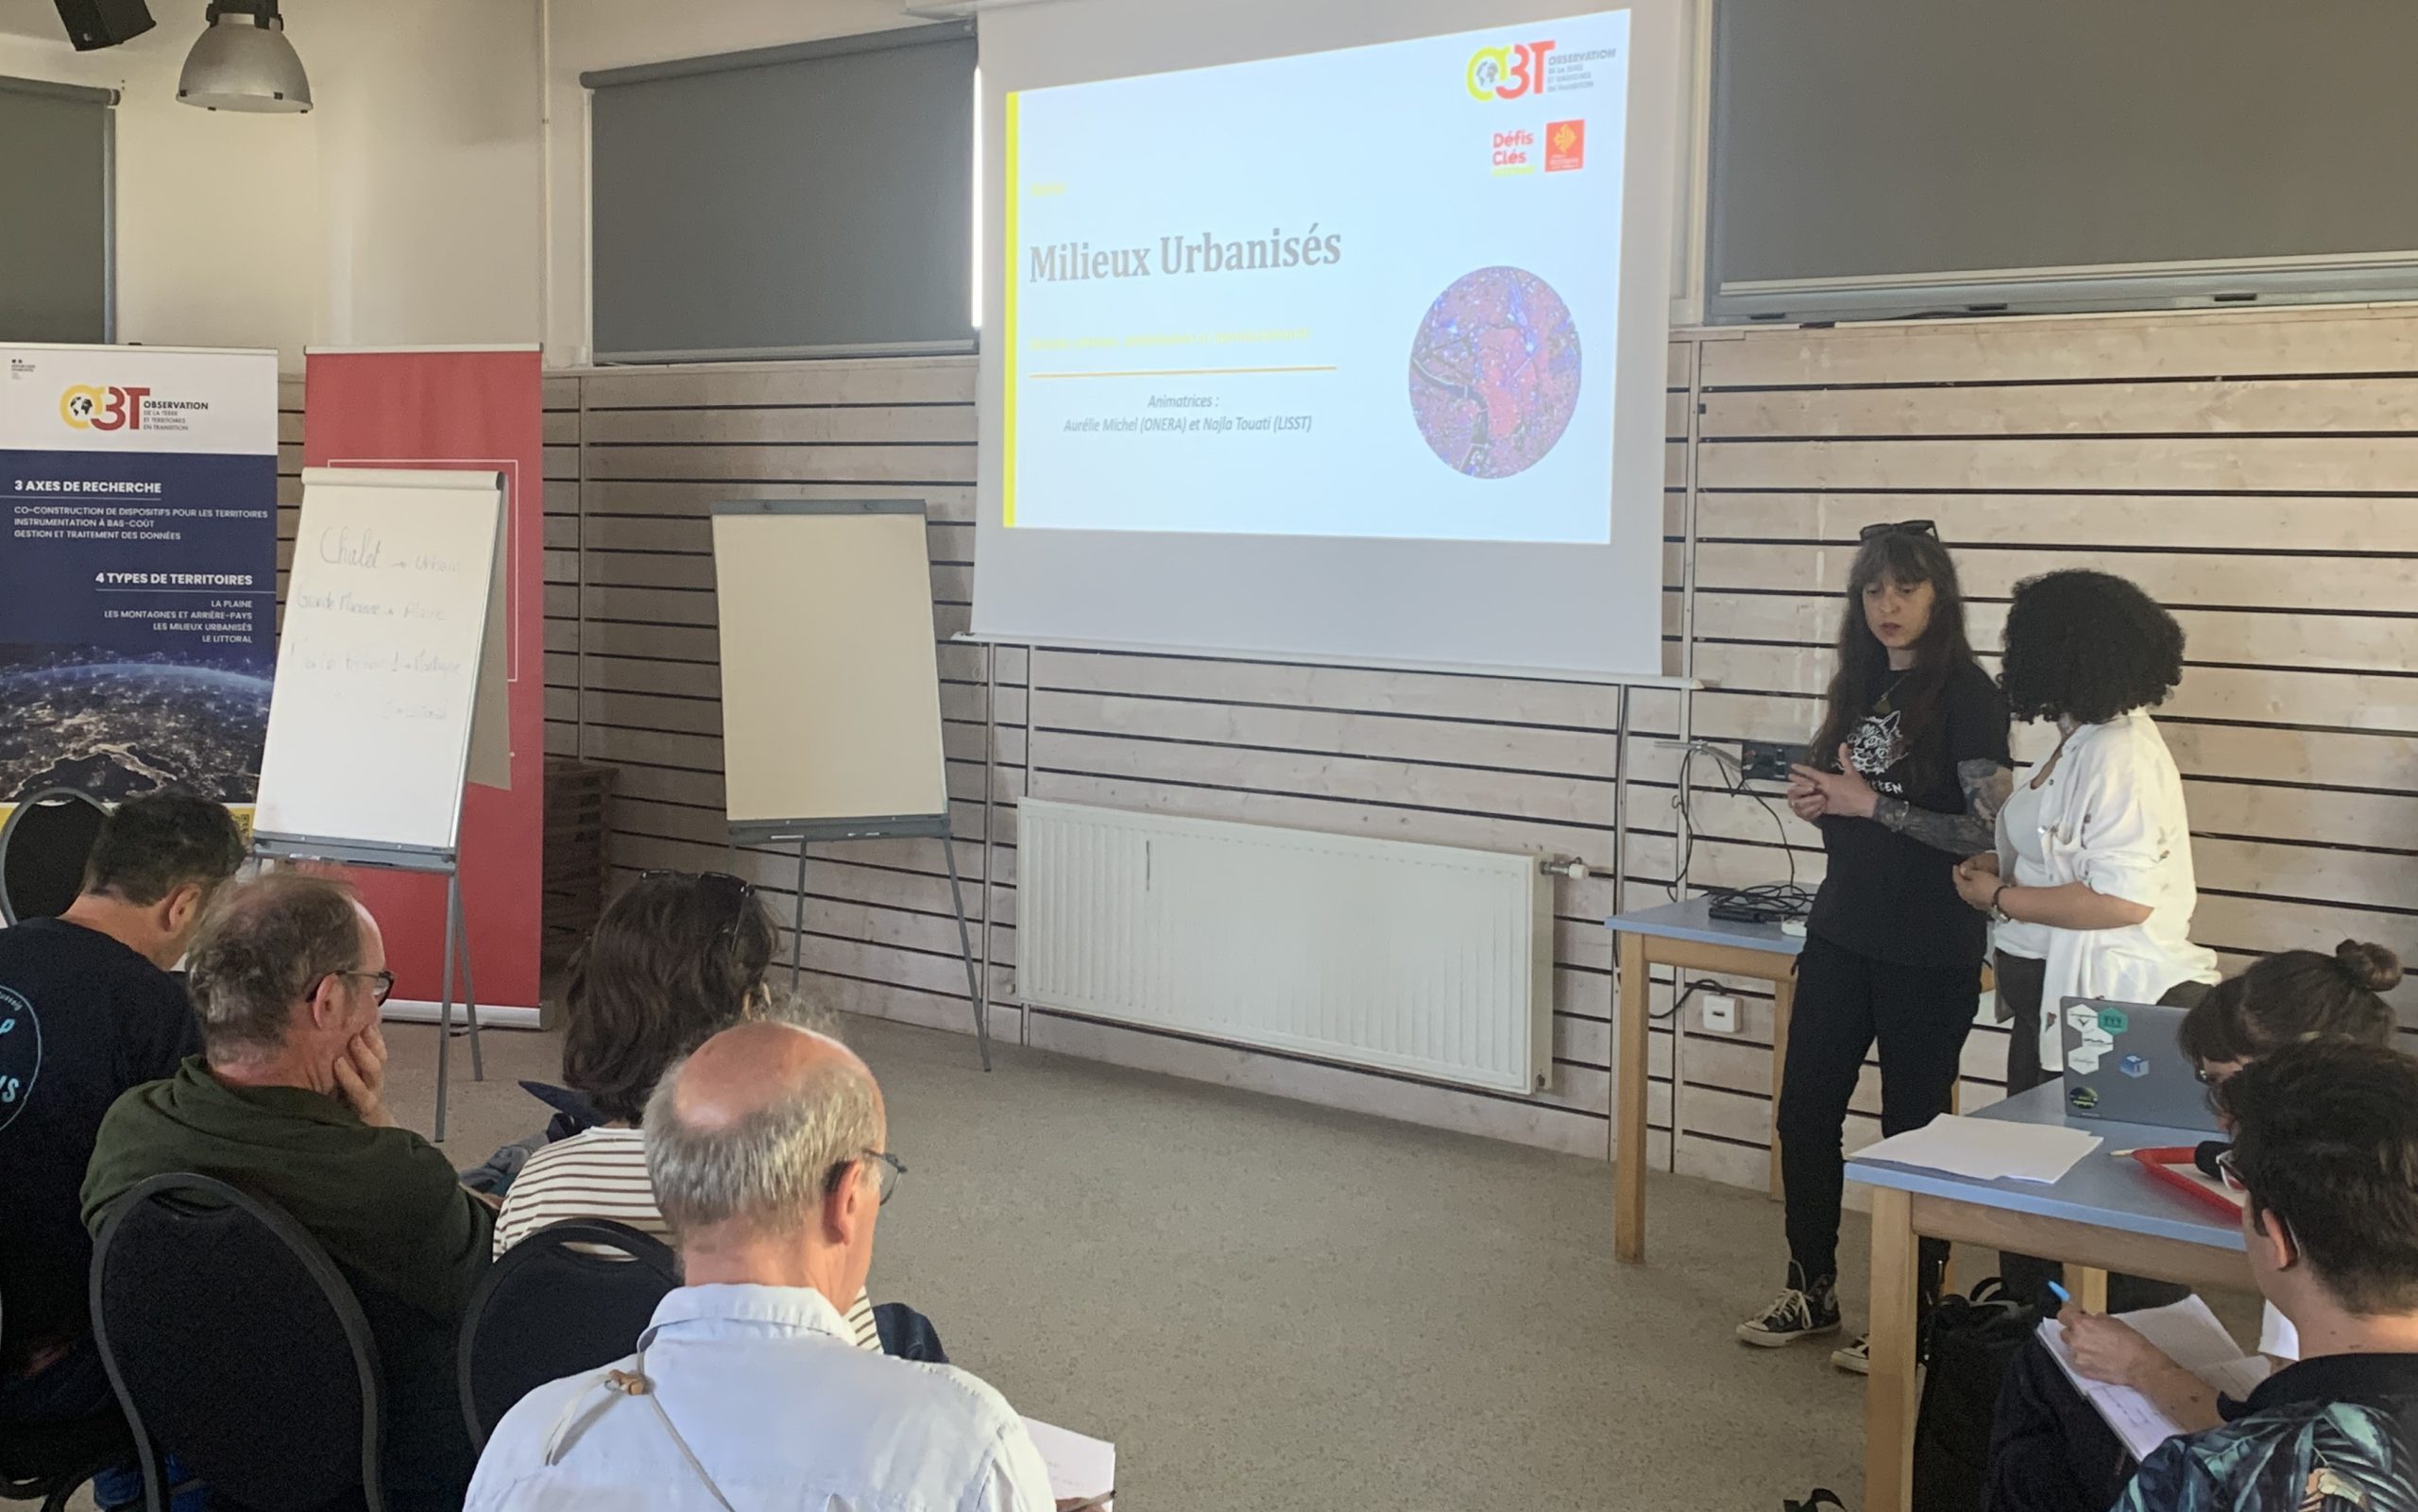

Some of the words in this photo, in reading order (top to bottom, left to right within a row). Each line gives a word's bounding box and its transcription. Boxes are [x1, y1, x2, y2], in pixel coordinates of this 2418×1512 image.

[1493, 130, 1534, 148] Défis
[1492, 149, 1526, 166] Clés
[1030, 242, 1151, 282] Milieux
[1160, 222, 1341, 275] Urbanisés
[144, 400, 209, 410] OBSERVATION
[1148, 395, 1213, 409] Animatrices
[1064, 416, 1099, 433] Aurélie
[1102, 416, 1138, 432] Michel
[1140, 416, 1187, 433] (ONERA)
[1189, 419, 1200, 432] et
[1202, 416, 1233, 433] Najla
[1235, 416, 1270, 432] Touati
[1273, 415, 1312, 433] (LISST)
[14, 480, 23, 490] 3
[26, 481, 60, 492] AXES
[63, 482, 80, 492] DE
[82, 482, 162, 494] RECHERCHE
[14, 506, 104, 516] CO-CONSTRUCTION
[106, 507, 117, 516] DE
[119, 507, 170, 517] DISPOSITIFS
[173, 508, 196, 518] POUR
[198, 508, 213, 518] LES
[215, 509, 268, 518] TERRITOIRES
[14, 518, 96, 527] INSTRUMENTATION
[98, 516, 105, 527] À
[107, 517, 154, 528] BAS-COÛT
[14, 529, 53, 538] GESTION
[55, 530, 64, 538] ET
[66, 530, 119, 539] TRAITEMENT
[121, 531, 138, 539] DES
[140, 530, 180, 540] DONNÉES
[320, 525, 381, 569] Chalet
[95, 572, 105, 584] 4
[107, 572, 148, 584] TYPES
[150, 573, 167, 585] DE
[170, 573, 253, 586] TERRITOIRES
[211, 600, 222, 608] LA
[104, 610, 119, 619] LES
[121, 610, 177, 619] MONTAGNES
[179, 611, 188, 620] ET
[190, 609, 252, 620] ARRIÈRE-PAYS
[153, 622, 167, 631] LES
[169, 622, 203, 631] MILIEUX
[205, 621, 252, 632] URBANISÉS
[202, 635, 212, 643] LE
[213, 635, 252, 643] LITTORAL
